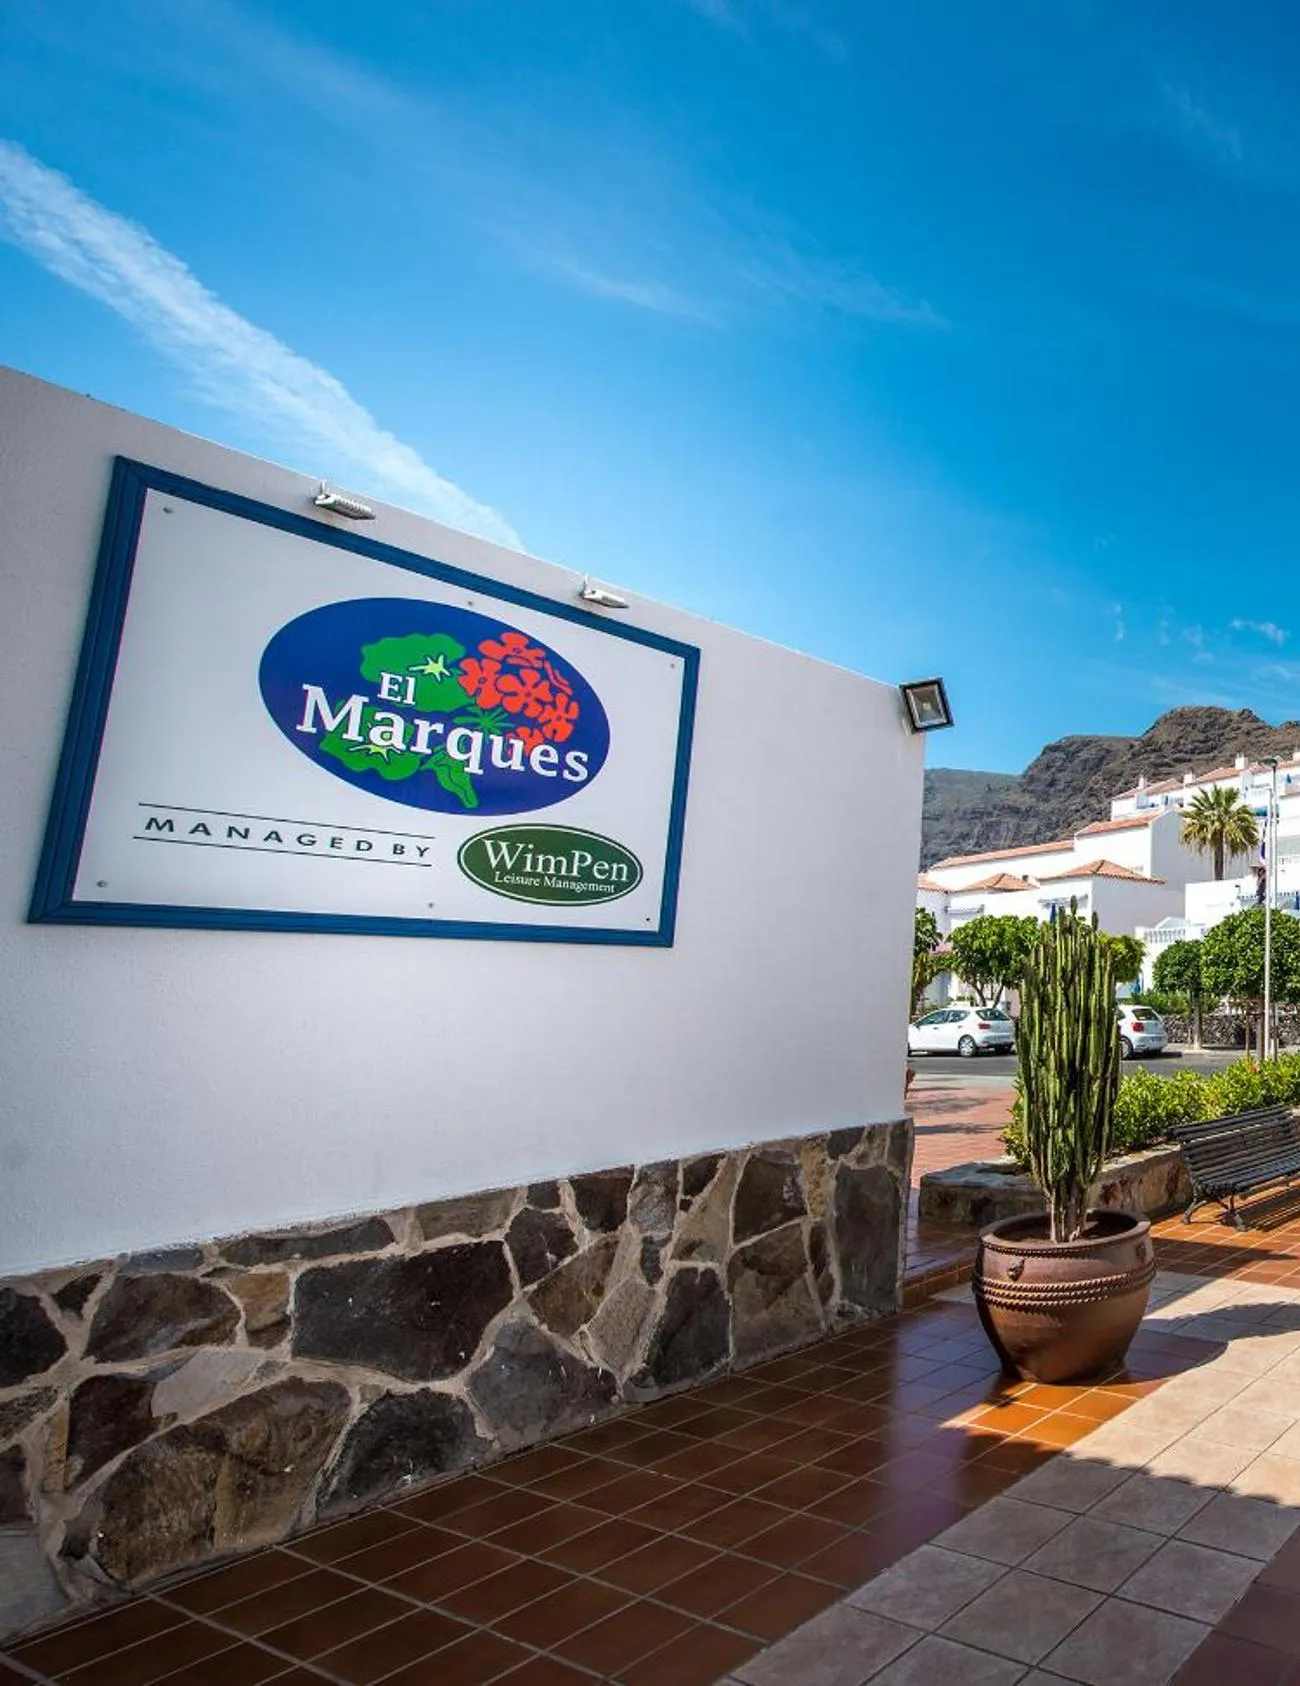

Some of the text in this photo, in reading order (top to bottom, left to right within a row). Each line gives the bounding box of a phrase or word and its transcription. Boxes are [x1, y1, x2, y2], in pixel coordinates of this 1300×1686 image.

[377, 672, 416, 705] El
[296, 683, 589, 782] Marques
[145, 817, 430, 858] MANAGED BY
[482, 838, 629, 883] WimPen
[494, 871, 615, 893] Leisure Management
